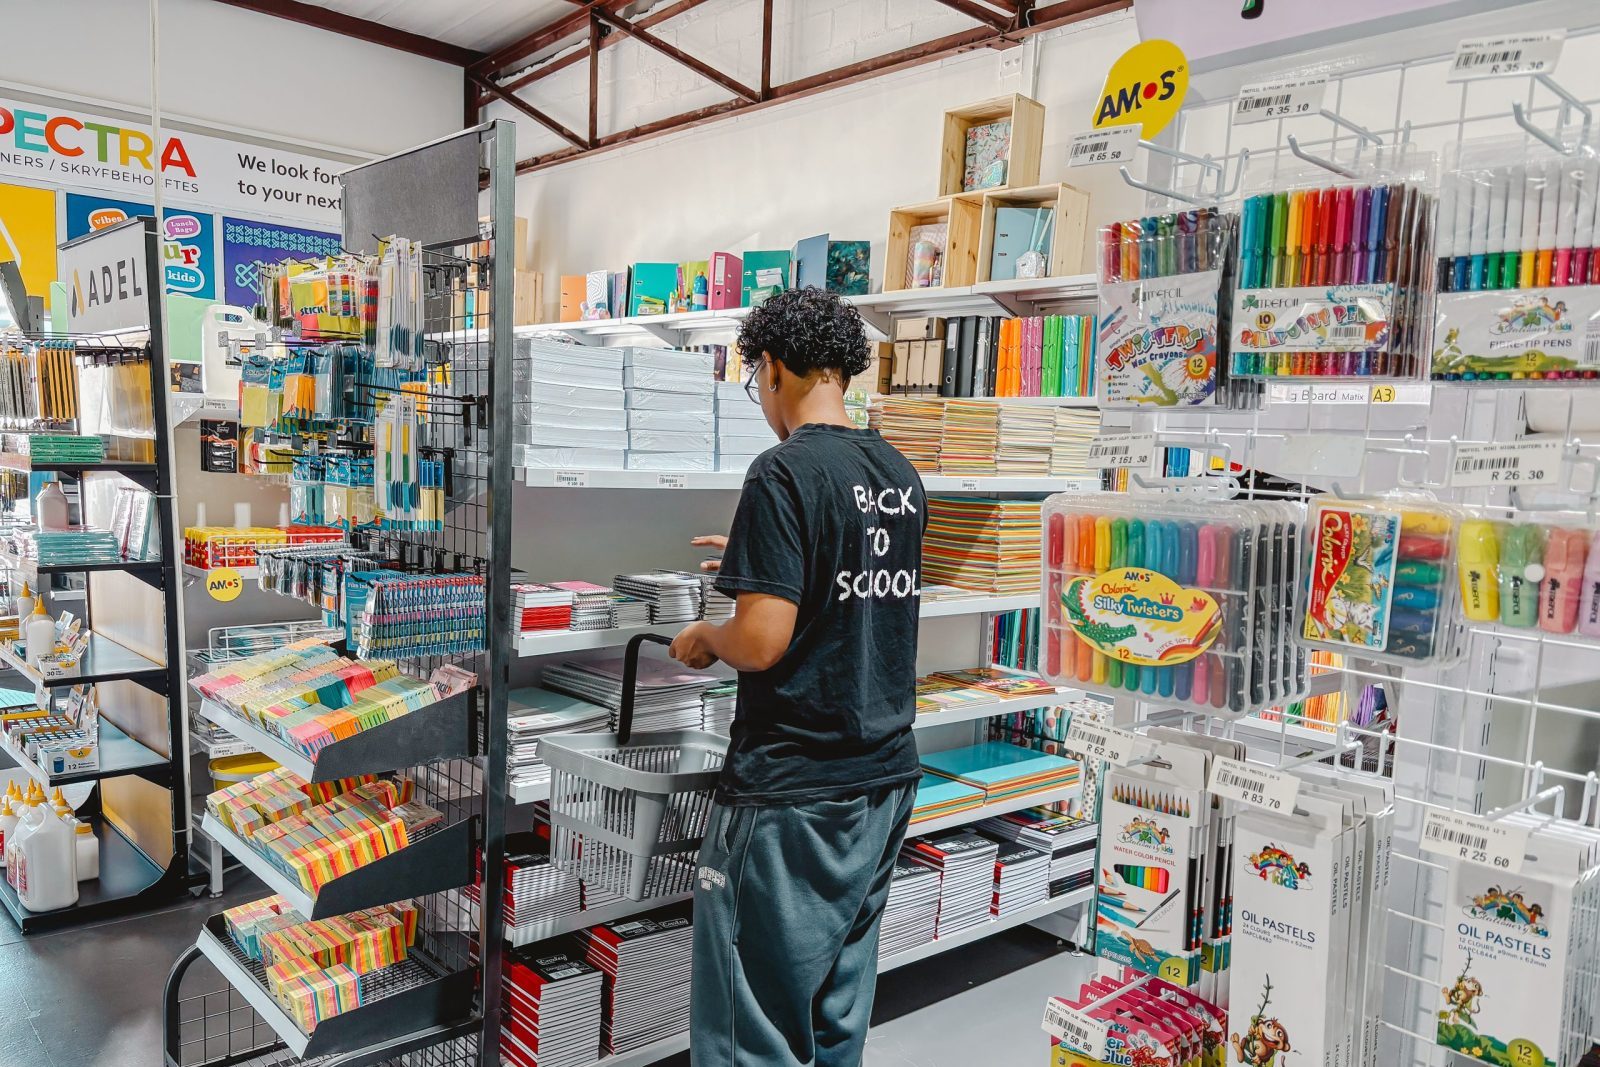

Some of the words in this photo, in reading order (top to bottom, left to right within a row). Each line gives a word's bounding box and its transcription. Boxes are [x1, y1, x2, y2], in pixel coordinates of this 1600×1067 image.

[1266, 107, 1273, 116] R
[237, 153, 266, 172] We
[272, 159, 309, 180] look
[61, 162, 199, 193] SKRYFBEHOFTES
[237, 180, 257, 195] to
[262, 186, 302, 202] your
[307, 194, 342, 210] next
[88, 257, 142, 307] ADEL
[167, 270, 196, 283] kids
[1259, 315, 1270, 324] 10
[1543, 338, 1572, 347] PENS
[1132, 357, 1147, 368] Wax
[1149, 351, 1184, 361] Crayons
[1193, 358, 1203, 368] 12
[1526, 353, 1537, 361] 12
[1301, 389, 1336, 400] Board
[1373, 388, 1391, 402] A3
[1491, 471, 1499, 480] R
[853, 485, 917, 515] BACK
[866, 526, 891, 557] TO
[1094, 595, 1123, 615] Silky
[1124, 599, 1180, 619] Twisters
[1118, 648, 1130, 659] 12
[1087, 744, 1093, 752] R
[1242, 791, 1249, 800] R
[1251, 793, 1281, 809] 83.70
[1113, 845, 1133, 854] WATER
[1134, 851, 1154, 861] COLOR
[1155, 856, 1176, 867] PENCIL
[1460, 847, 1468, 857] R
[1471, 850, 1509, 868] 25.60
[1259, 869, 1267, 881] 4
[1272, 869, 1298, 890] kids
[1242, 910, 1260, 925] OIL
[1262, 917, 1316, 943] PASTELS
[1458, 923, 1481, 940] OIL
[1486, 931, 1551, 960] PASTELS
[1468, 939, 1495, 952] CLOURS
[1200, 955, 1208, 964] 2
[1166, 966, 1181, 978] 12
[1063, 1031, 1068, 1039] R
[1517, 1044, 1532, 1058] 12
[1518, 1056, 1532, 1066] PCS
